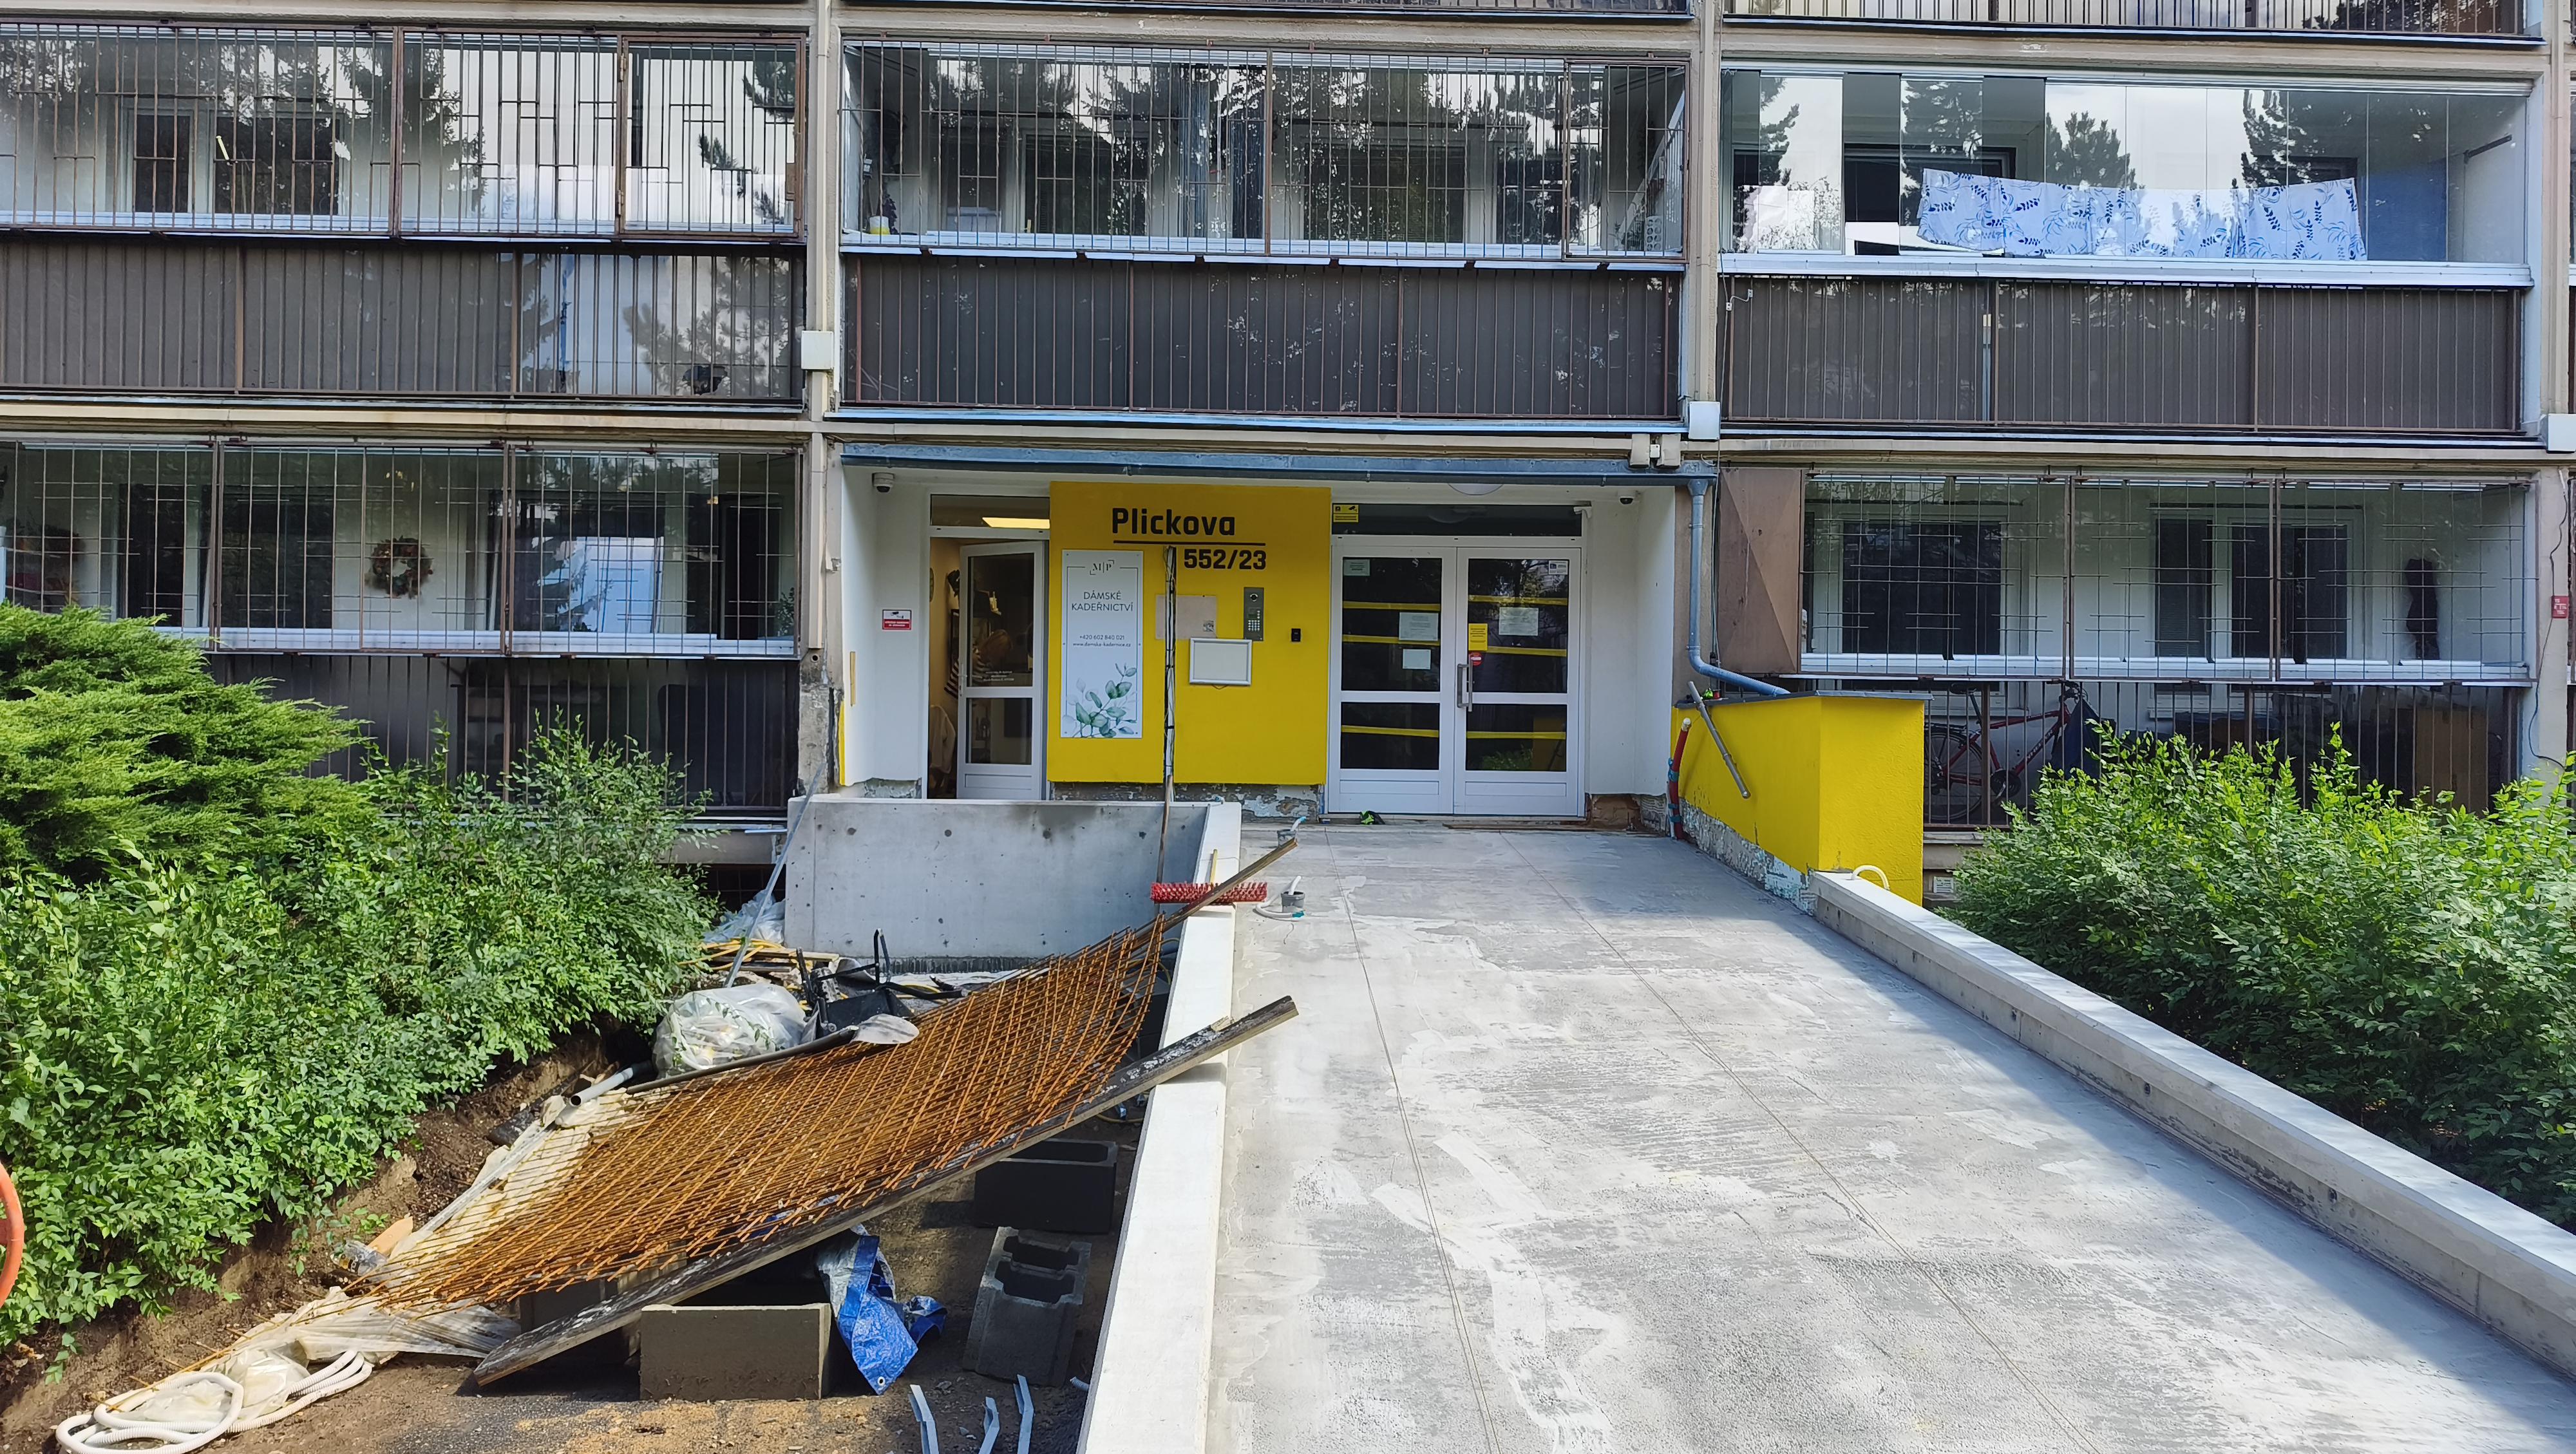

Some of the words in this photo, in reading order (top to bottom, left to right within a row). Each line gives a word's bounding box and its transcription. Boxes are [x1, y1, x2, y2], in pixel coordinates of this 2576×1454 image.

[1112, 507, 1235, 536] Plickova
[1184, 549, 1267, 570] 552/23
[1083, 590, 1122, 600] DÁMSKÉ
[1072, 601, 1133, 611] KADEŘNICTVÍ
